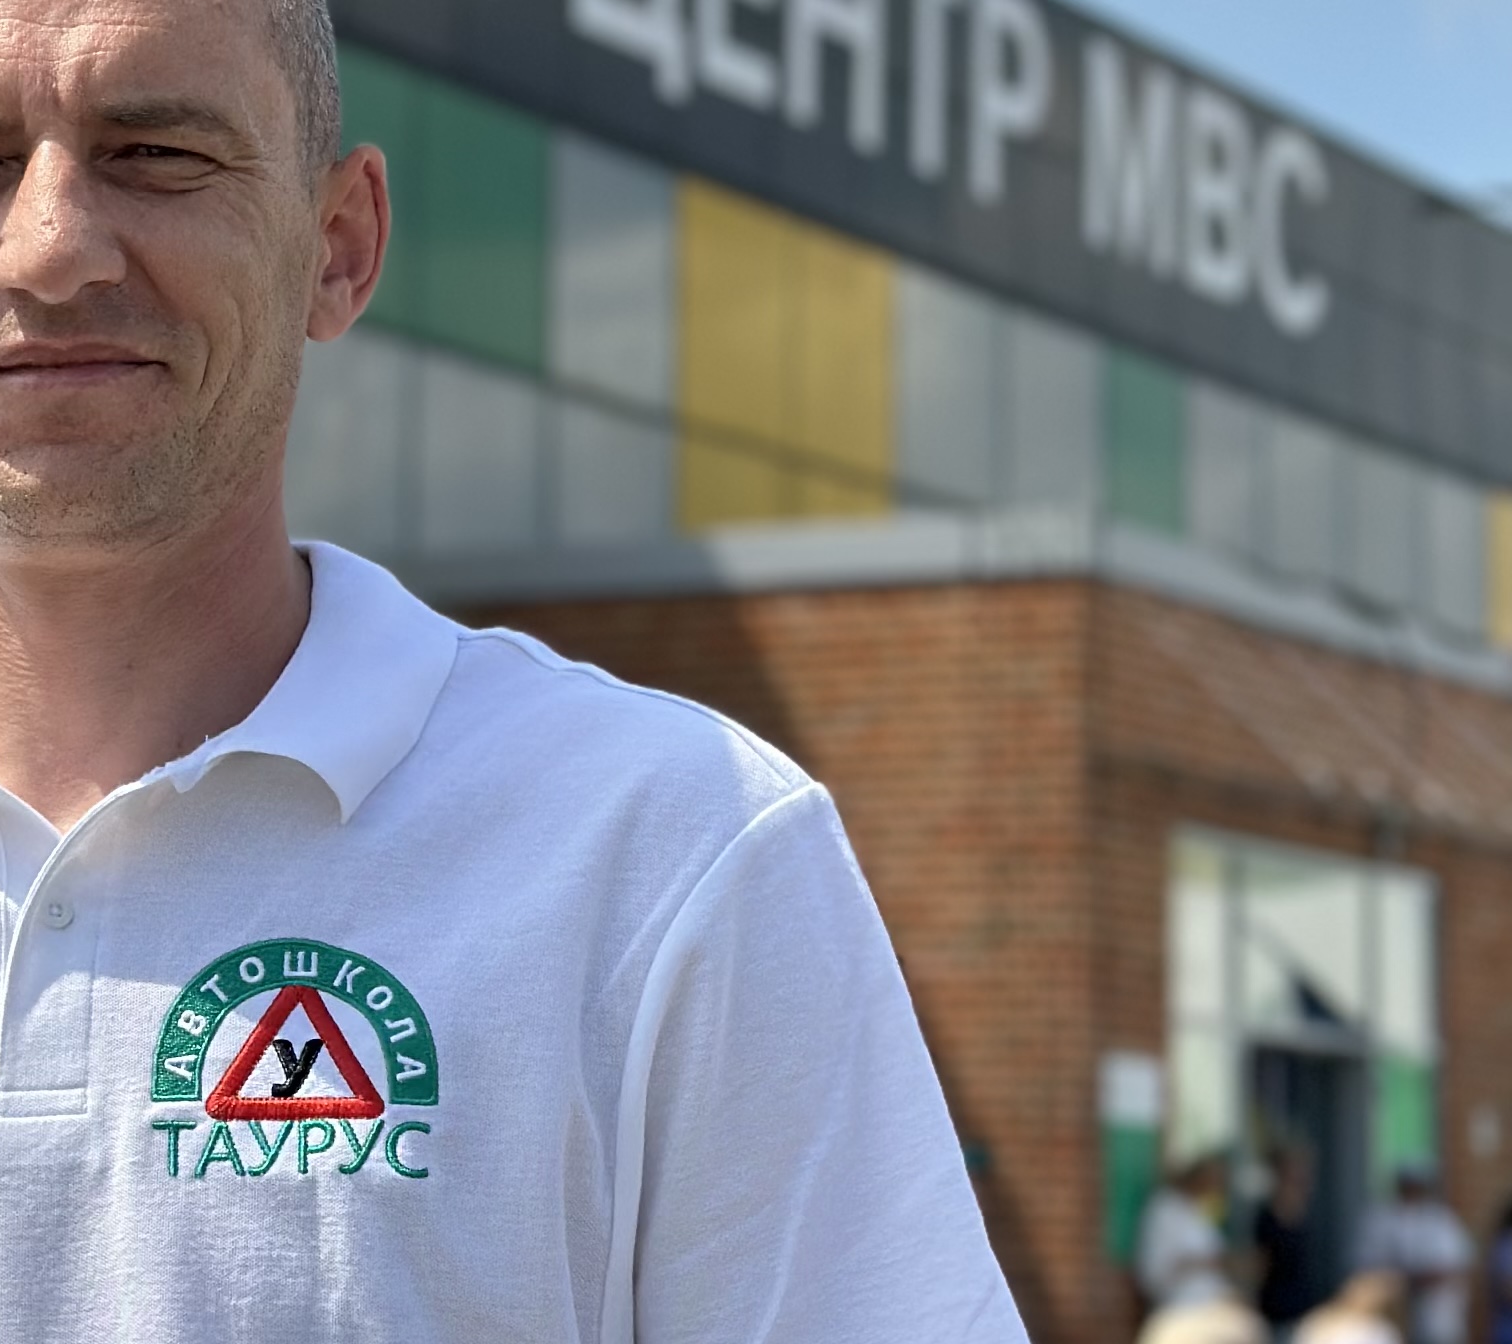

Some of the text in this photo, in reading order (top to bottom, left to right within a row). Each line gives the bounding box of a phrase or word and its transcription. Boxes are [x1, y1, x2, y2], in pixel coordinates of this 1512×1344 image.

[1080, 35, 1330, 337] МВС
[163, 950, 427, 1082] АВТОШКОЛА
[151, 1119, 432, 1179] ТАУРУС
